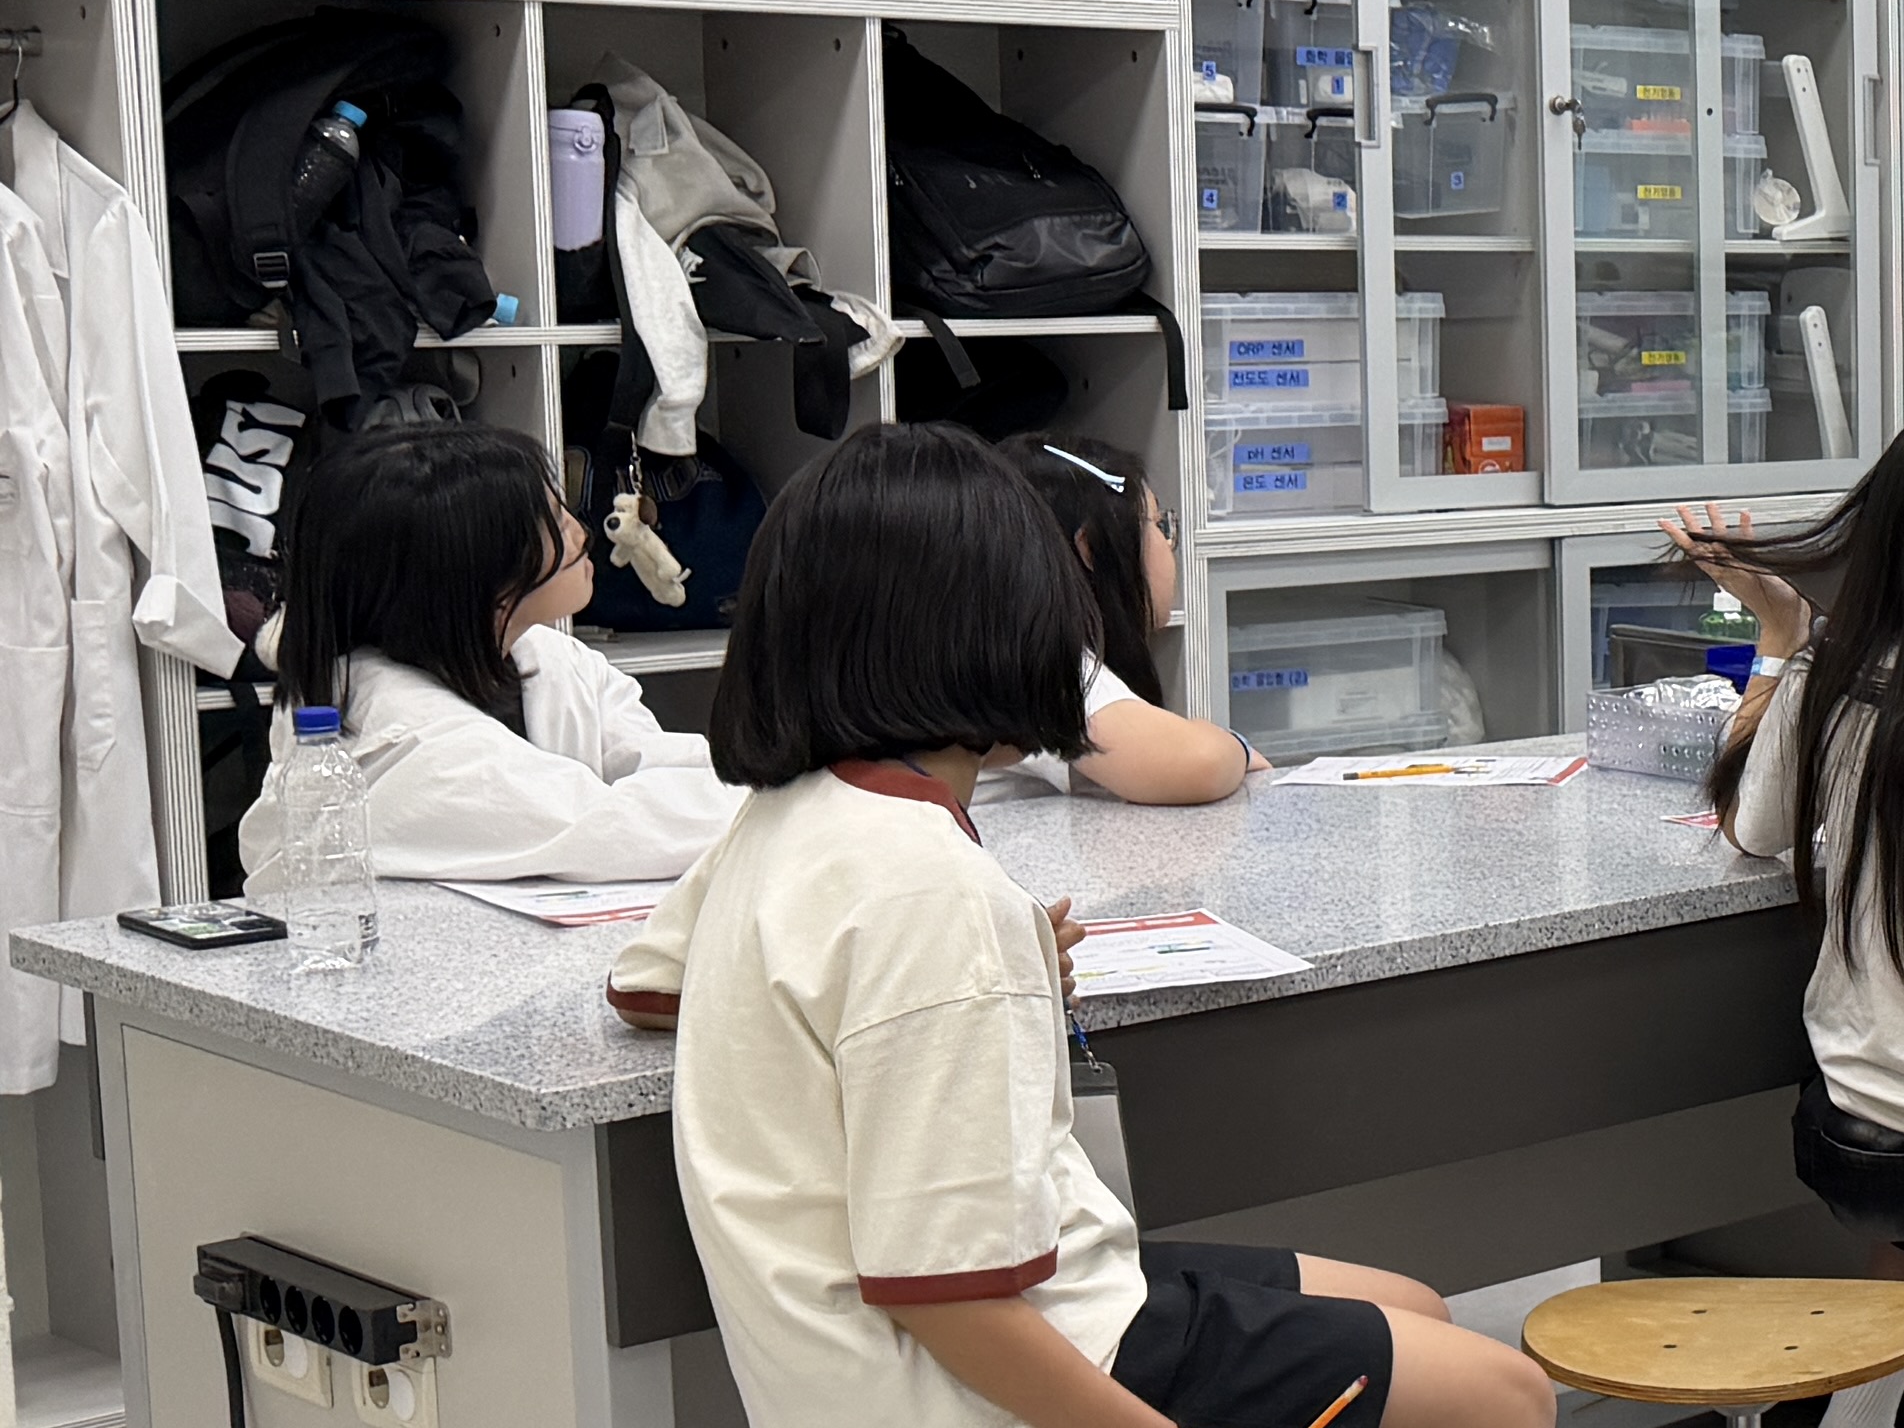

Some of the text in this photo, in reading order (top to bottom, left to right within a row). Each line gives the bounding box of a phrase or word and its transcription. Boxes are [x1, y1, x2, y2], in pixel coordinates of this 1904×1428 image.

[1205, 64, 1215, 78] 5
[1334, 78, 1342, 91] 1
[1453, 175, 1462, 187] 3
[1205, 192, 1215, 205] 4
[1336, 194, 1346, 207] 2
[1237, 342, 1296, 357] ORP 센서
[1276, 371, 1300, 386] 센서
[1247, 446, 1295, 461] pH 센서
[1242, 474, 1298, 490] 온도 센서
